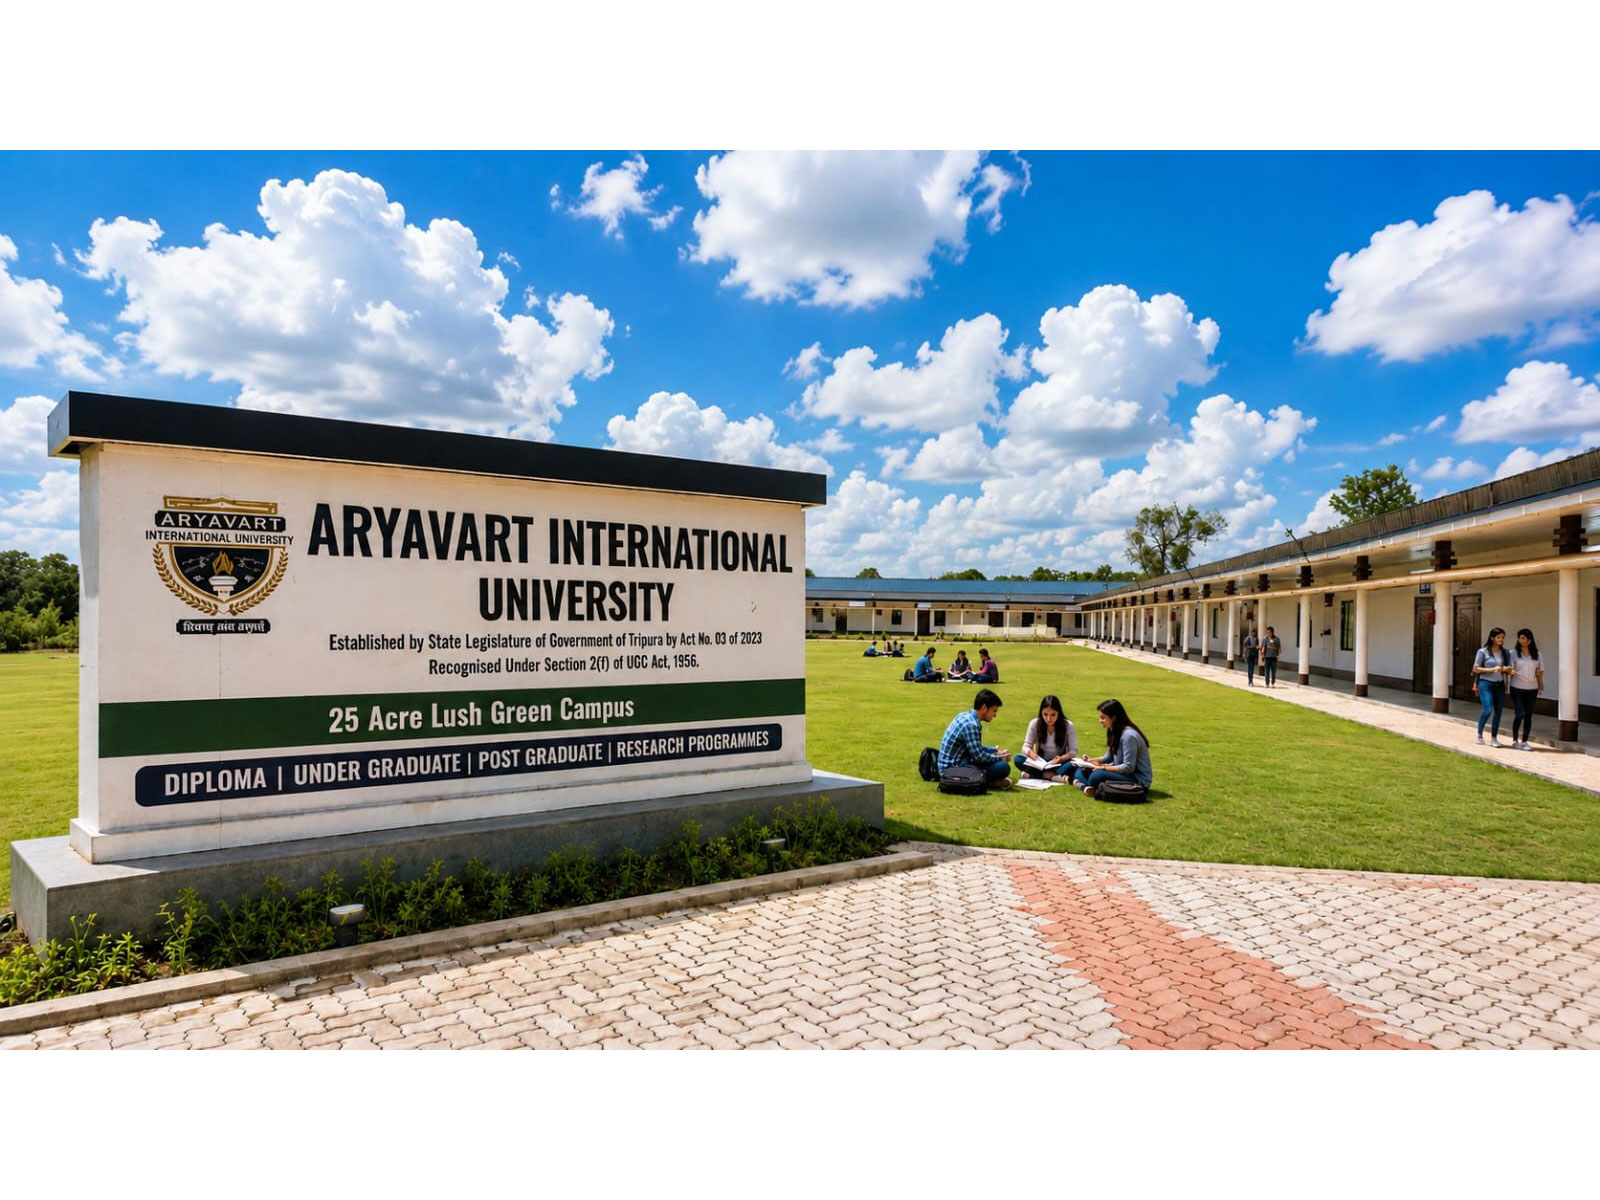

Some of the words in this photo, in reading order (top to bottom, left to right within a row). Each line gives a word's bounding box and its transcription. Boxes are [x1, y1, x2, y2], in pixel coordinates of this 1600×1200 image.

[160, 512, 281, 531] ARYAVART
[145, 530, 231, 543] INTERNATIONAL
[235, 534, 294, 545] UNIVERSITY
[307, 503, 534, 564] ARYAVART
[549, 518, 793, 573] INTERNATIONAL
[479, 577, 674, 621] UNIVERSITY
[329, 634, 404, 651] Established
[409, 634, 424, 653] by
[428, 633, 461, 649] State
[465, 633, 531, 651] Legislature
[535, 633, 546, 648] of
[549, 632, 613, 647] Government
[615, 632, 627, 647] of
[628, 632, 663, 649] Tripura
[666, 632, 677, 648] by
[680, 632, 696, 645] Act
[698, 632, 713, 645] No.
[715, 632, 726, 645] 03
[729, 632, 738, 645] of
[740, 631, 762, 645] 2023
[428, 659, 501, 677] Recognised
[505, 657, 540, 672] Under
[544, 656, 586, 671] Section
[589, 655, 610, 672] 2(f)
[613, 655, 624, 669] of
[626, 655, 648, 669] UGC
[651, 655, 671, 670] Act,
[673, 654, 700, 668] 1956.
[328, 706, 359, 733] 25
[368, 705, 423, 731] Acre
[431, 702, 482, 728] Lush
[491, 700, 552, 725] Green
[560, 697, 635, 723] Campus
[164, 767, 267, 796] DIPLOMA
[294, 762, 361, 785] UNDER
[367, 753, 461, 779] GRADUATE
[478, 749, 520, 770] POST
[525, 743, 603, 766] GRADUATE
[616, 737, 685, 758] RESEARCH
[688, 730, 770, 752] PROGRAMMES
